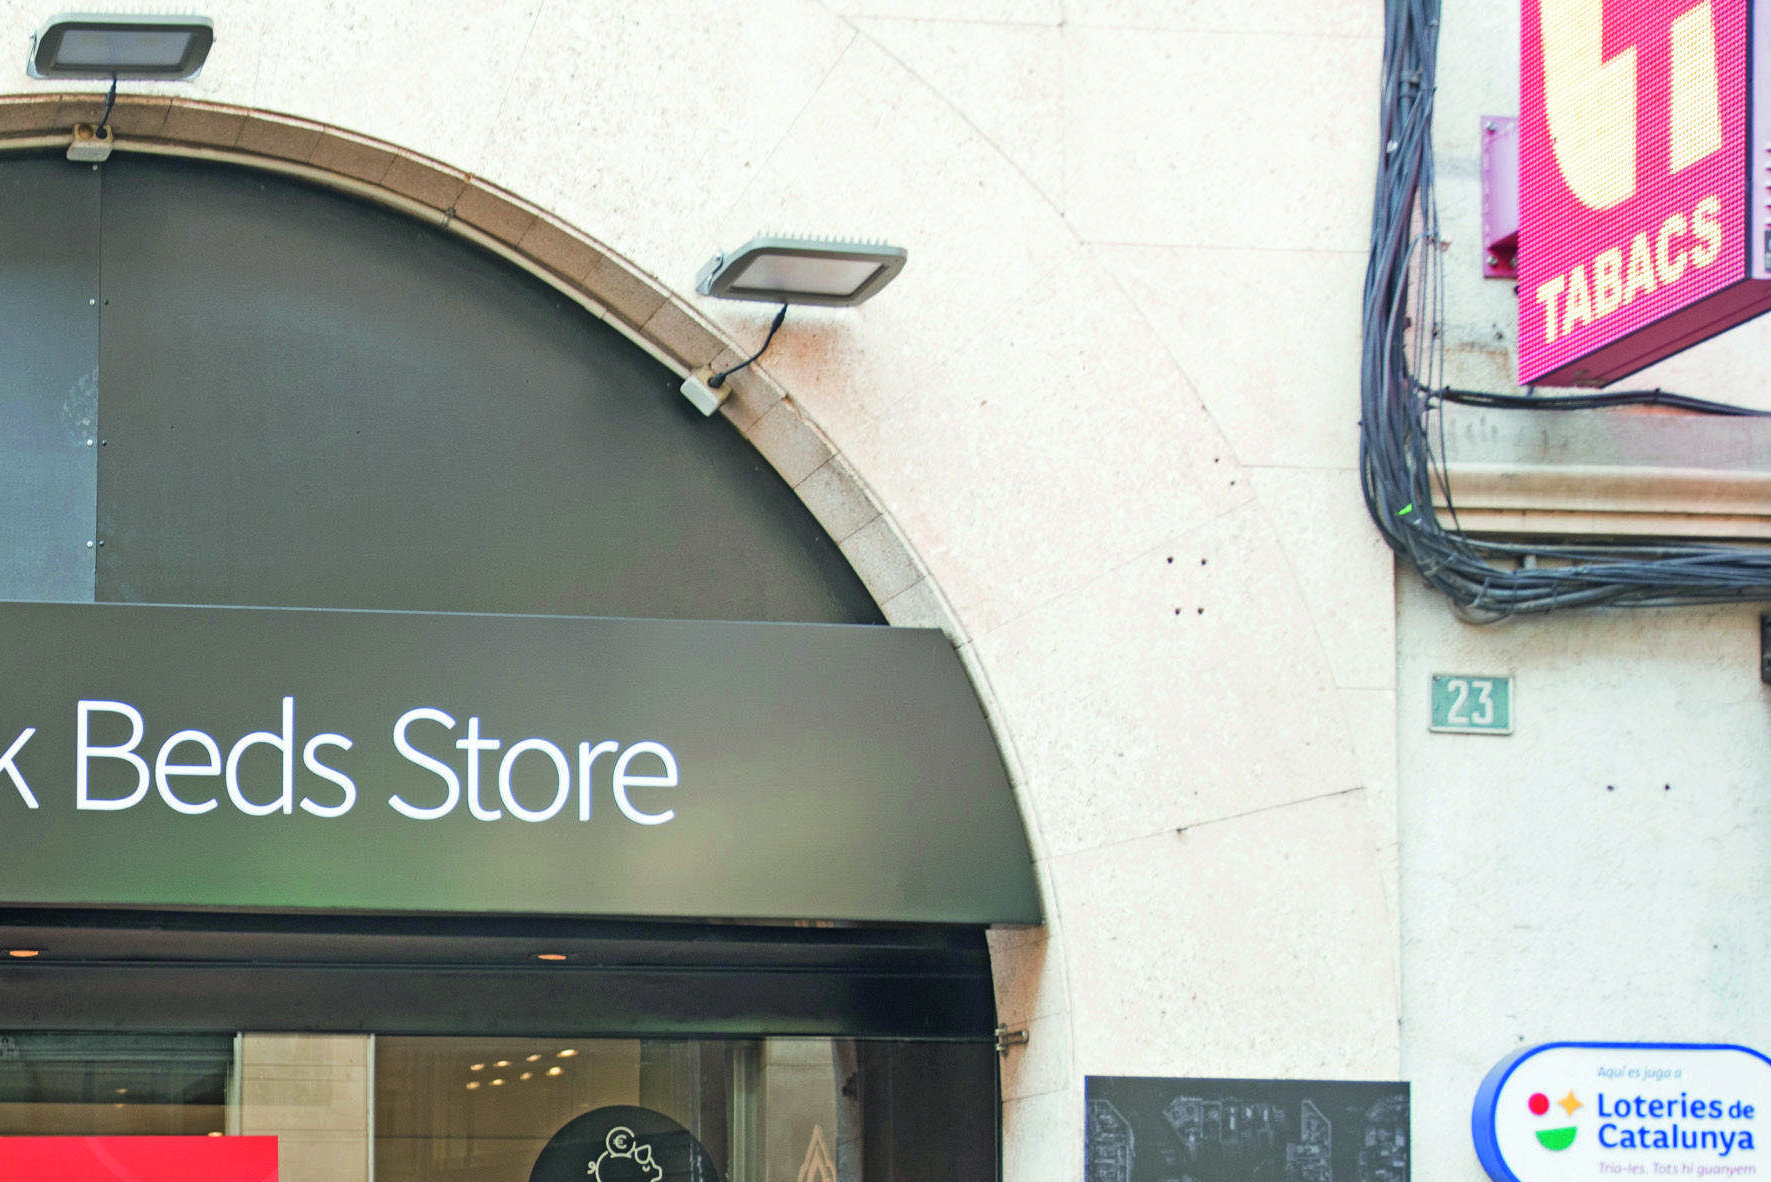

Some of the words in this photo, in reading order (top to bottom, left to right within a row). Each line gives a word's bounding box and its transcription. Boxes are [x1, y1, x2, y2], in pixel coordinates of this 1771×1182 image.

[1536, 195, 1722, 345] TABACS
[1447, 680, 1494, 724] 23
[75, 695, 357, 818] Beds
[388, 707, 679, 826] Store
[1598, 1066, 1626, 1080] Aquí
[1628, 1068, 1641, 1078] es
[1644, 1066, 1671, 1081] juga
[1674, 1069, 1682, 1078] a
[1598, 1092, 1723, 1119] Loteries
[1728, 1100, 1755, 1119] de
[1598, 1123, 1755, 1157] Catalunya
[1653, 1162, 1679, 1175] Tots
[1682, 1163, 1694, 1175] hi
[1697, 1164, 1757, 1178] guanyem
